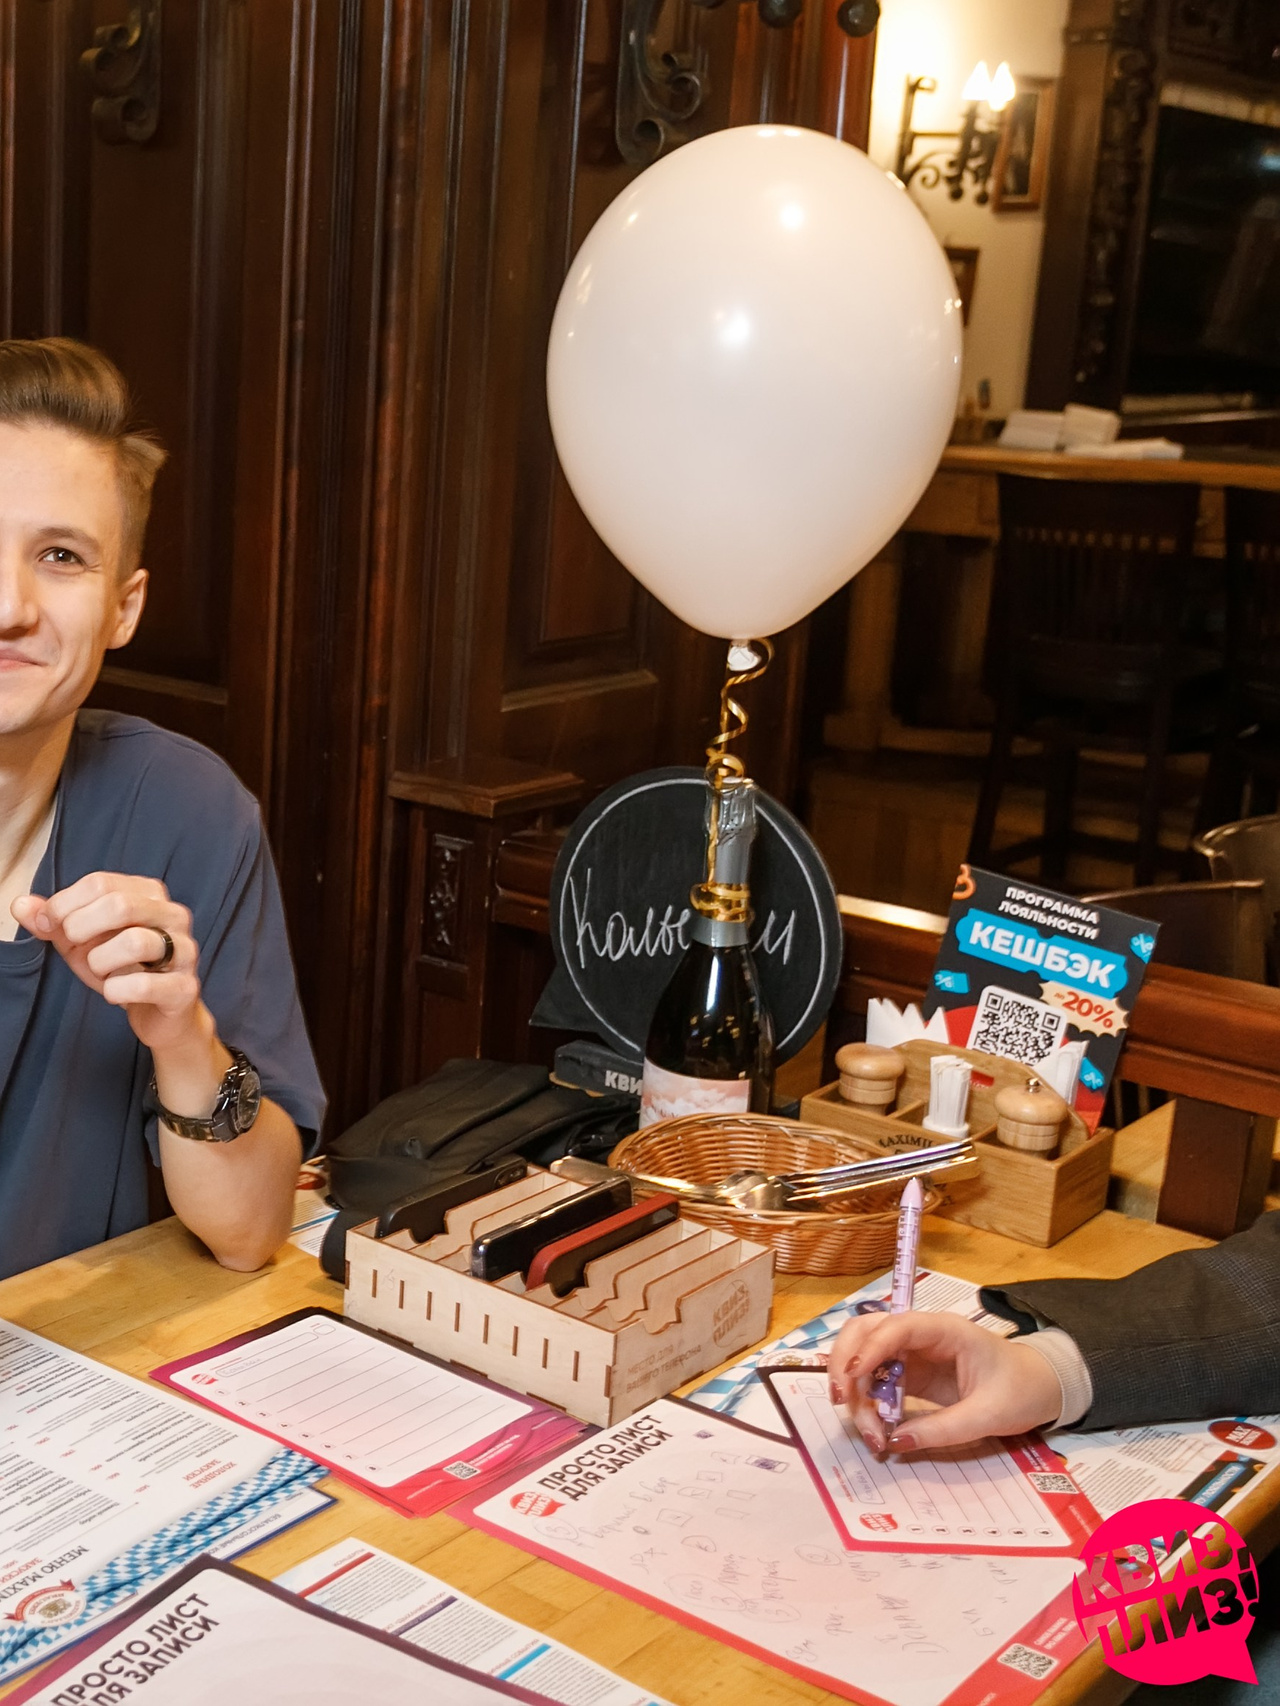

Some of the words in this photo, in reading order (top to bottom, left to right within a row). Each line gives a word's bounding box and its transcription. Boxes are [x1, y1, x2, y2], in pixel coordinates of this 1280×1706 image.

[998, 901, 1100, 940] ЛОЯЛЬНОСТИ
[1006, 886, 1100, 925] ПРОГРАММА
[969, 920, 1117, 989] КЕШБЭК
[1062, 991, 1114, 1029] 20%
[537, 1443, 617, 1491] ПРОСТО
[609, 1414, 662, 1446] ЛИСТ
[1225, 1425, 1253, 1443] MAX
[180, 1459, 222, 1480] ЗАКУСКИ
[186, 1461, 238, 1488] ХОЛОДНЫЕ
[558, 1471, 606, 1501] ДЛЯ
[596, 1429, 674, 1475] ЗАПИСИ
[36, 1545, 90, 1574] МЕНЮ
[50, 1640, 151, 1706] ПРОСТО
[145, 1593, 209, 1642] ЛИСТ
[77, 1682, 133, 1706] ЛЯ
[123, 1615, 221, 1685] ЗАПИСИ
